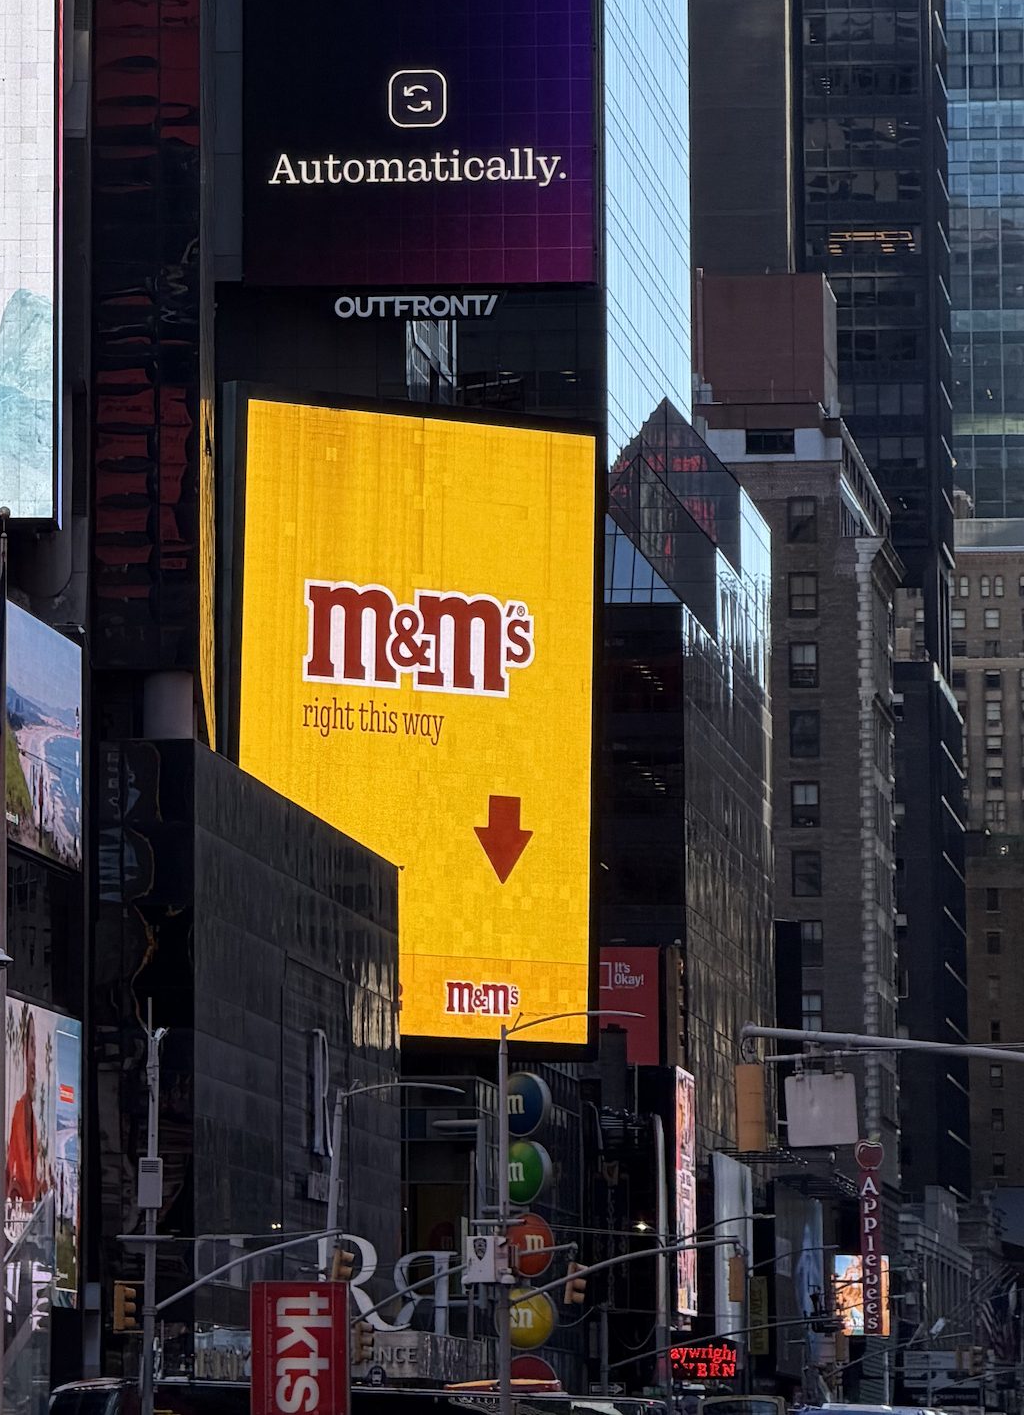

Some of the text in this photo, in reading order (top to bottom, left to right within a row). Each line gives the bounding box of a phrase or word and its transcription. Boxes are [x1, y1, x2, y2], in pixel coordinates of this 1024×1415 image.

[268, 148, 567, 187] Automatically.
[302, 697, 445, 746] right this way
[614, 962, 631, 974] It's
[614, 973, 644, 986] Okay!
[507, 1093, 525, 1114] m
[507, 1162, 525, 1182] m
[525, 1234, 545, 1252] m
[510, 1307, 533, 1328] m
[275, 1291, 333, 1414] tkts
